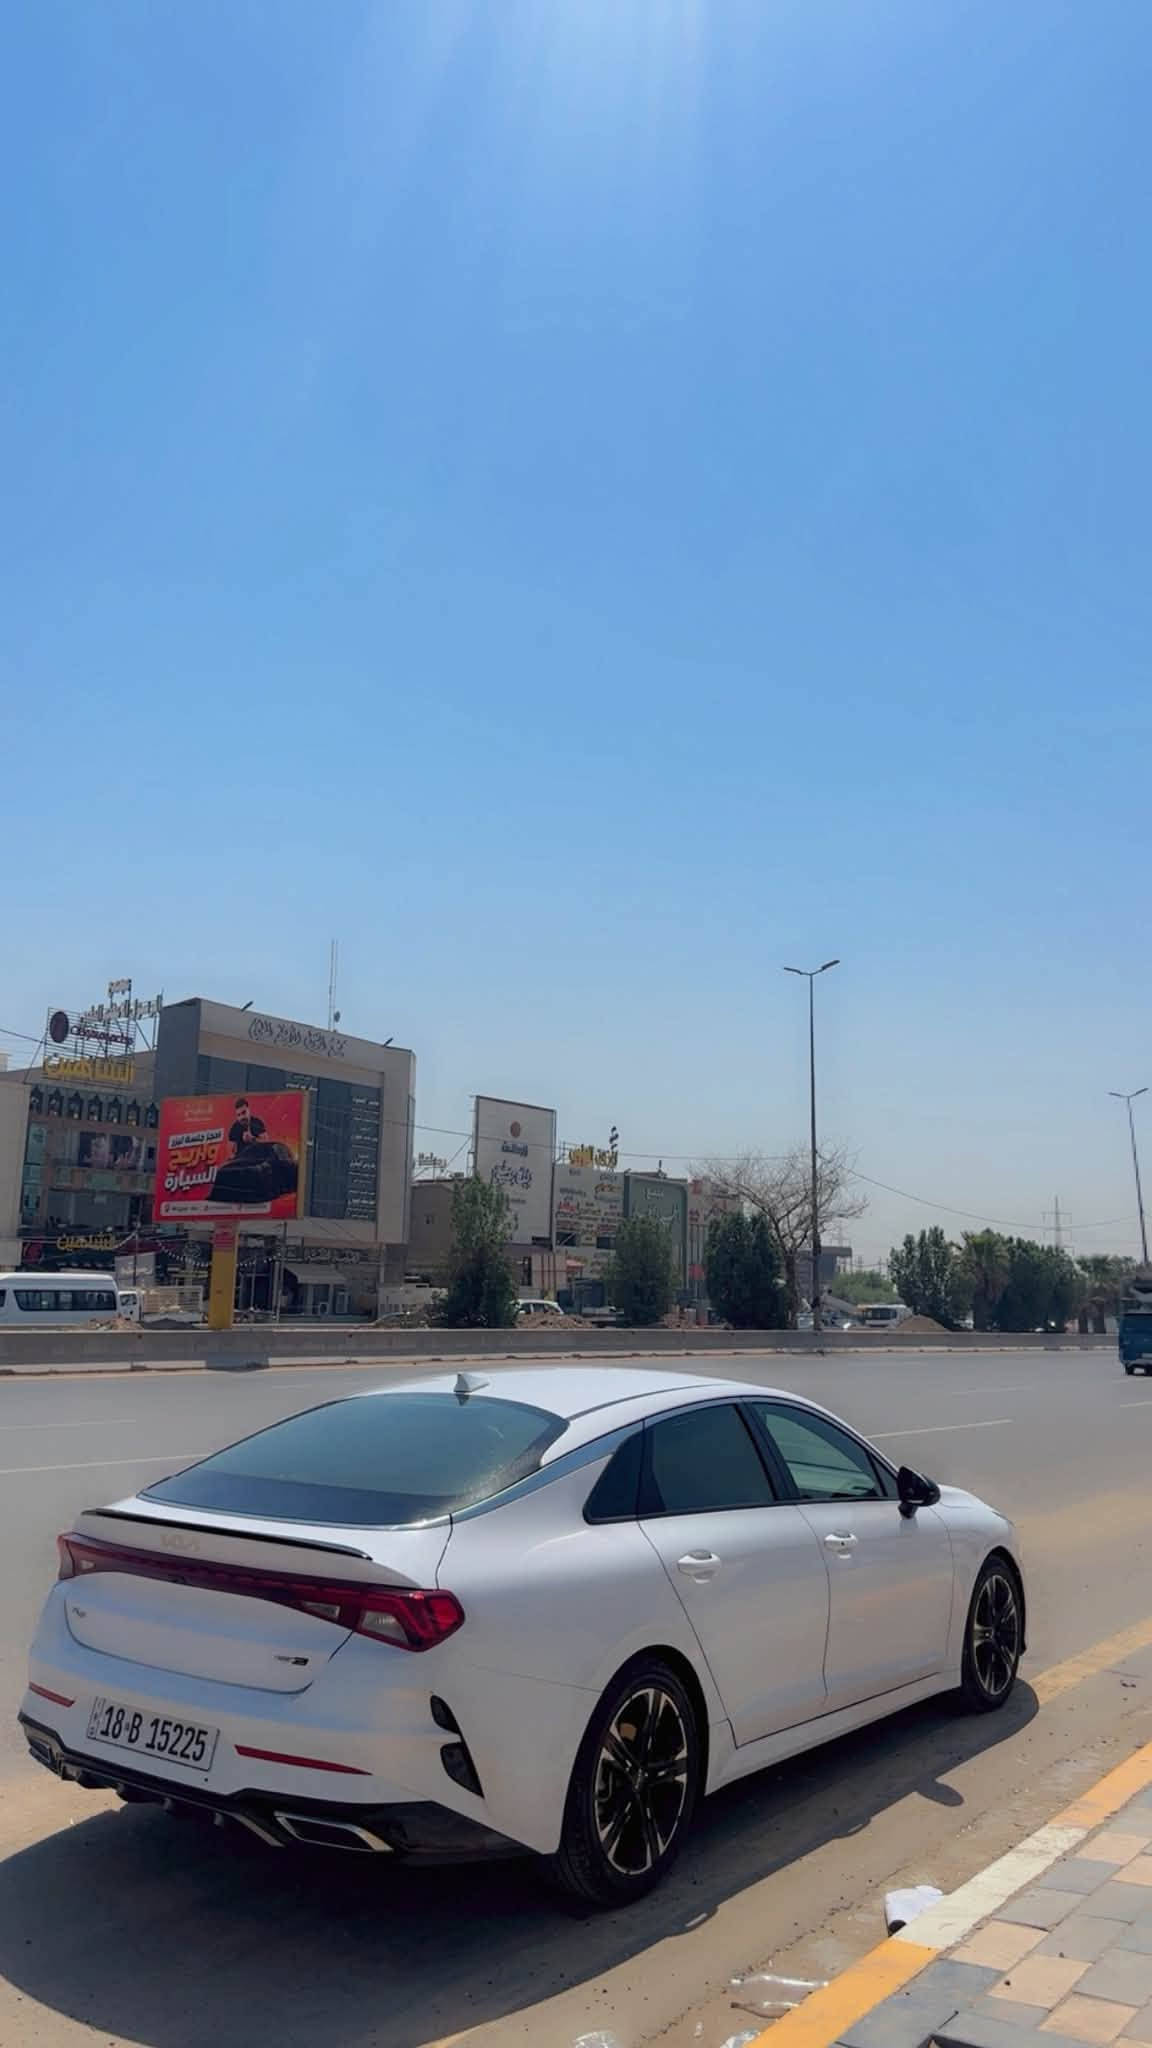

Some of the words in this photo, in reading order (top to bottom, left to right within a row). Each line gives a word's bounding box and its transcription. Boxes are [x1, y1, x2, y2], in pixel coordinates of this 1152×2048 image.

[164, 1166, 218, 1192] السيارة
[100, 1705, 126, 1739] 18
[128, 1711, 143, 1744] B
[145, 1717, 208, 1762] 15225
